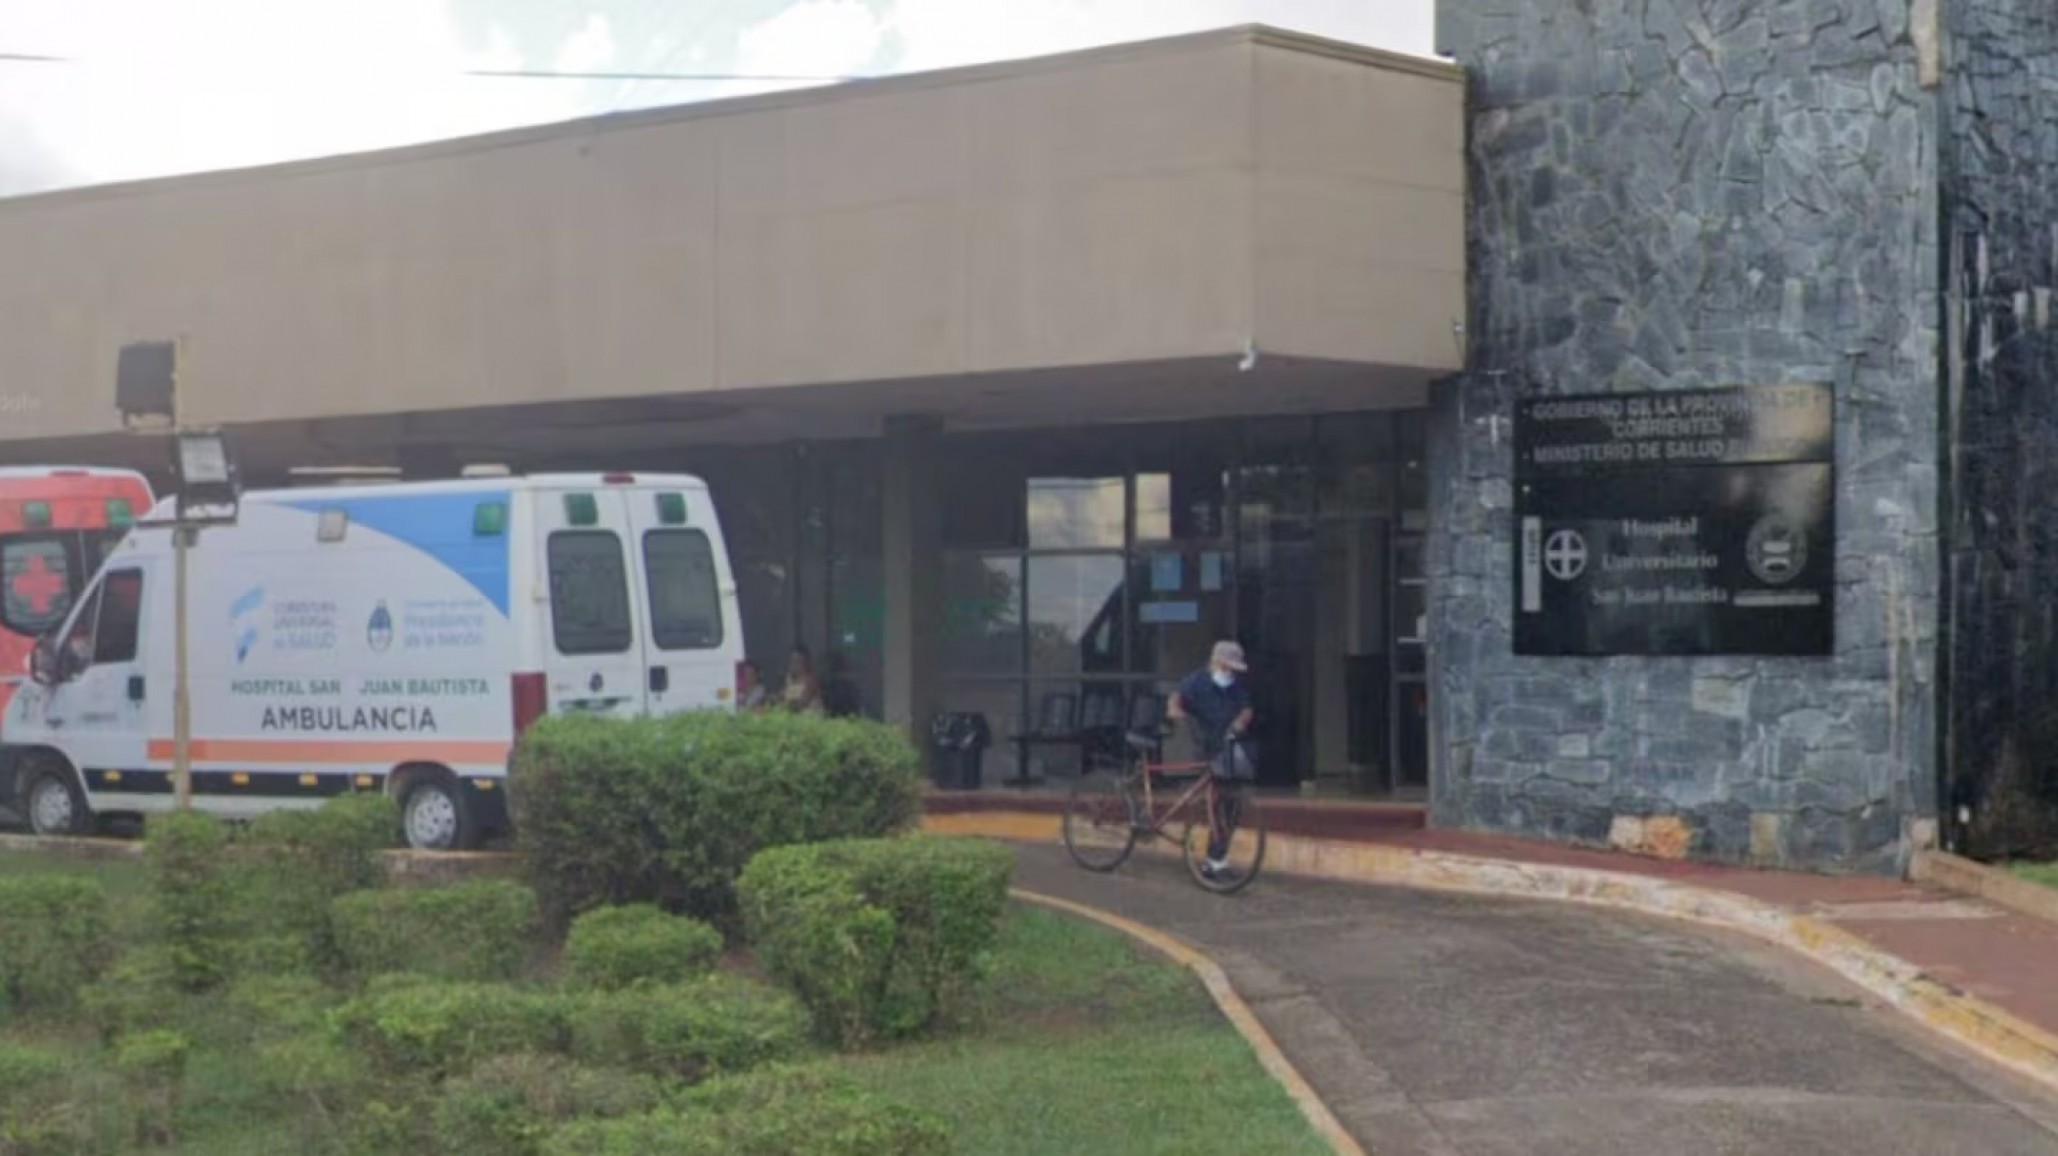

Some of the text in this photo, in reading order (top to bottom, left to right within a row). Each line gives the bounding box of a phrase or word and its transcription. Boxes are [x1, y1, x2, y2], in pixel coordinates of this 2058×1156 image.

[1531, 400, 1621, 420] GOBIERNO
[1627, 397, 1651, 416] DE
[1655, 396, 1680, 416] LA
[1613, 418, 1724, 438] CORRIENTES
[1534, 442, 1633, 463] MINISTERIO
[1637, 441, 1661, 460] DE
[1666, 439, 1723, 460] SALUD
[1621, 516, 1698, 541] Hospital
[231, 679, 490, 696] HOSPITAL SAN JUAN BAUTISTA
[260, 705, 438, 732] AMBULANCIA
